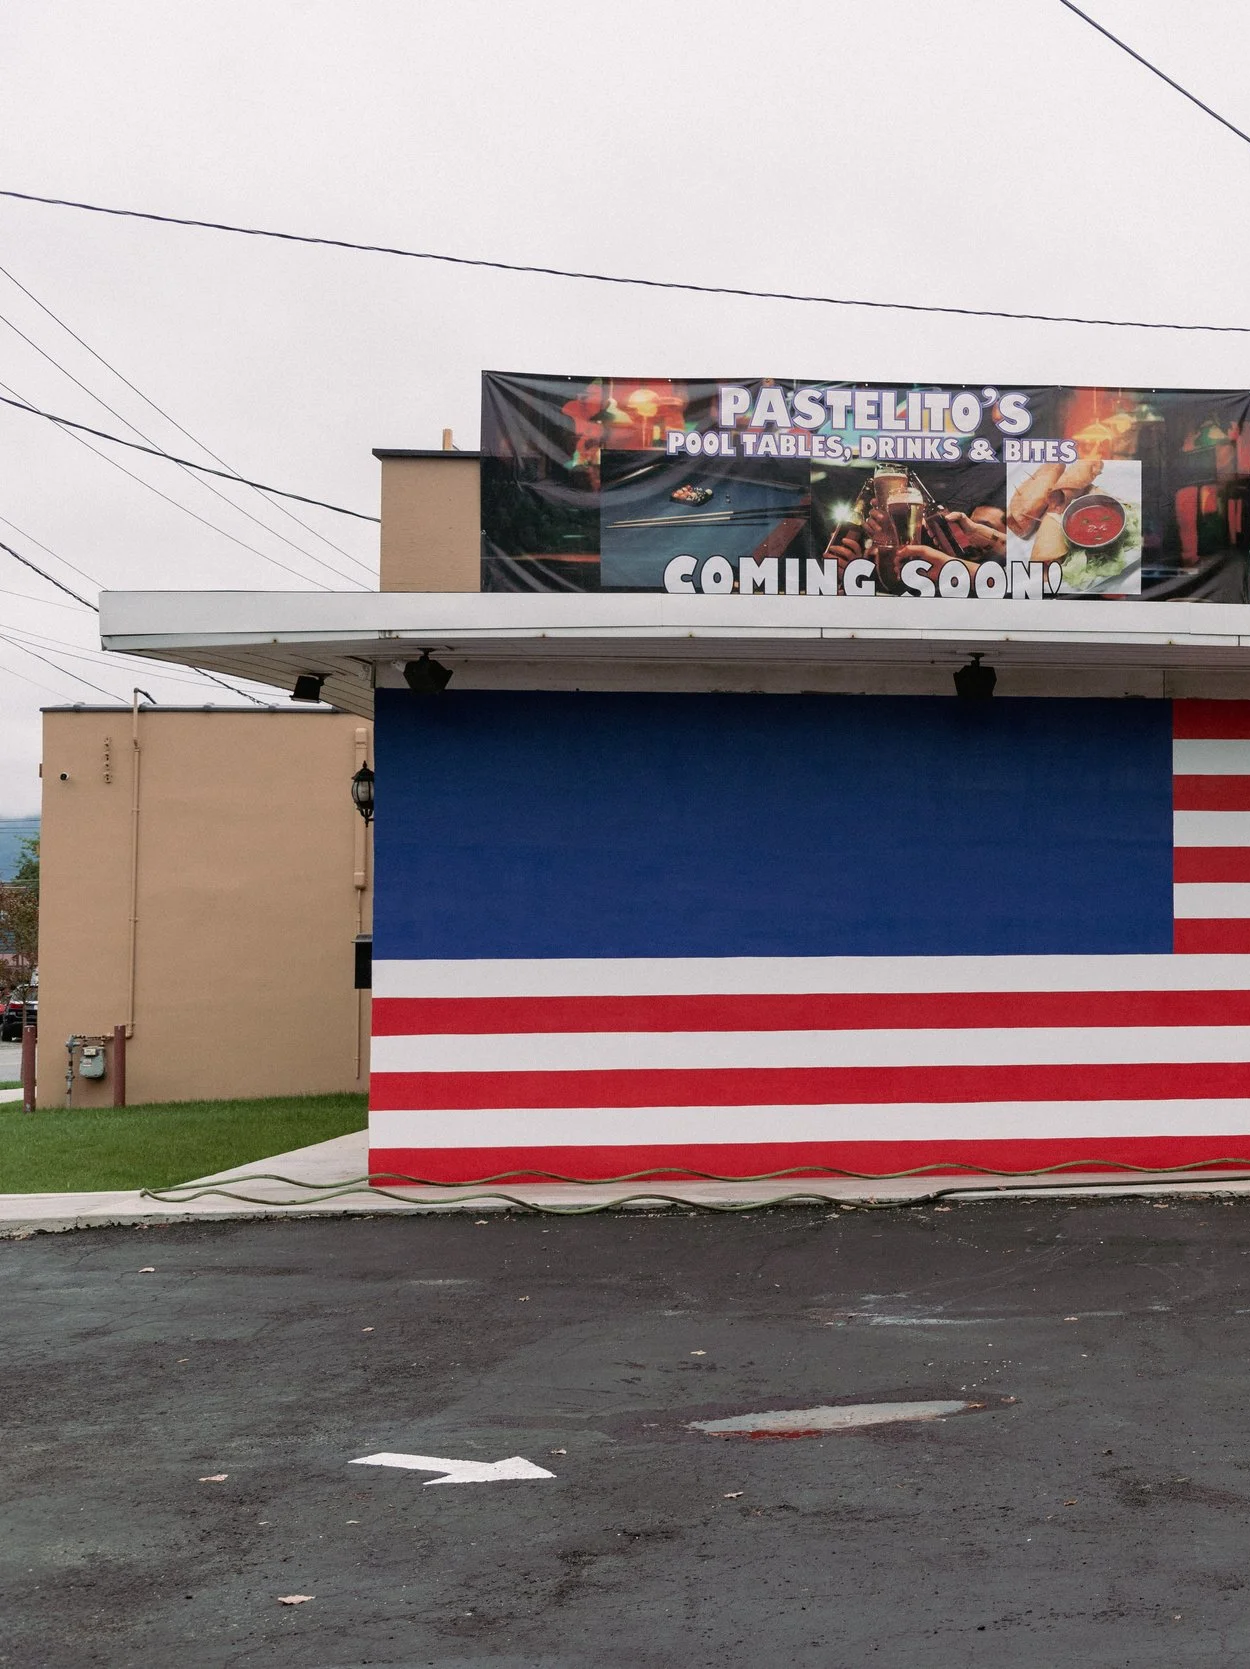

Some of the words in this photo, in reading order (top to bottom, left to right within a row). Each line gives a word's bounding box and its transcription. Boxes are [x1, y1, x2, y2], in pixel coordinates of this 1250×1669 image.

[719, 386, 1031, 434] PASTELITO'S
[667, 431, 736, 456] POOL
[740, 432, 852, 463] TABLES,
[858, 435, 962, 462] DRINKS
[968, 438, 999, 463] &
[1003, 438, 1078, 463] BITES
[663, 554, 876, 596] COMING
[900, 559, 1062, 600] SOON!
